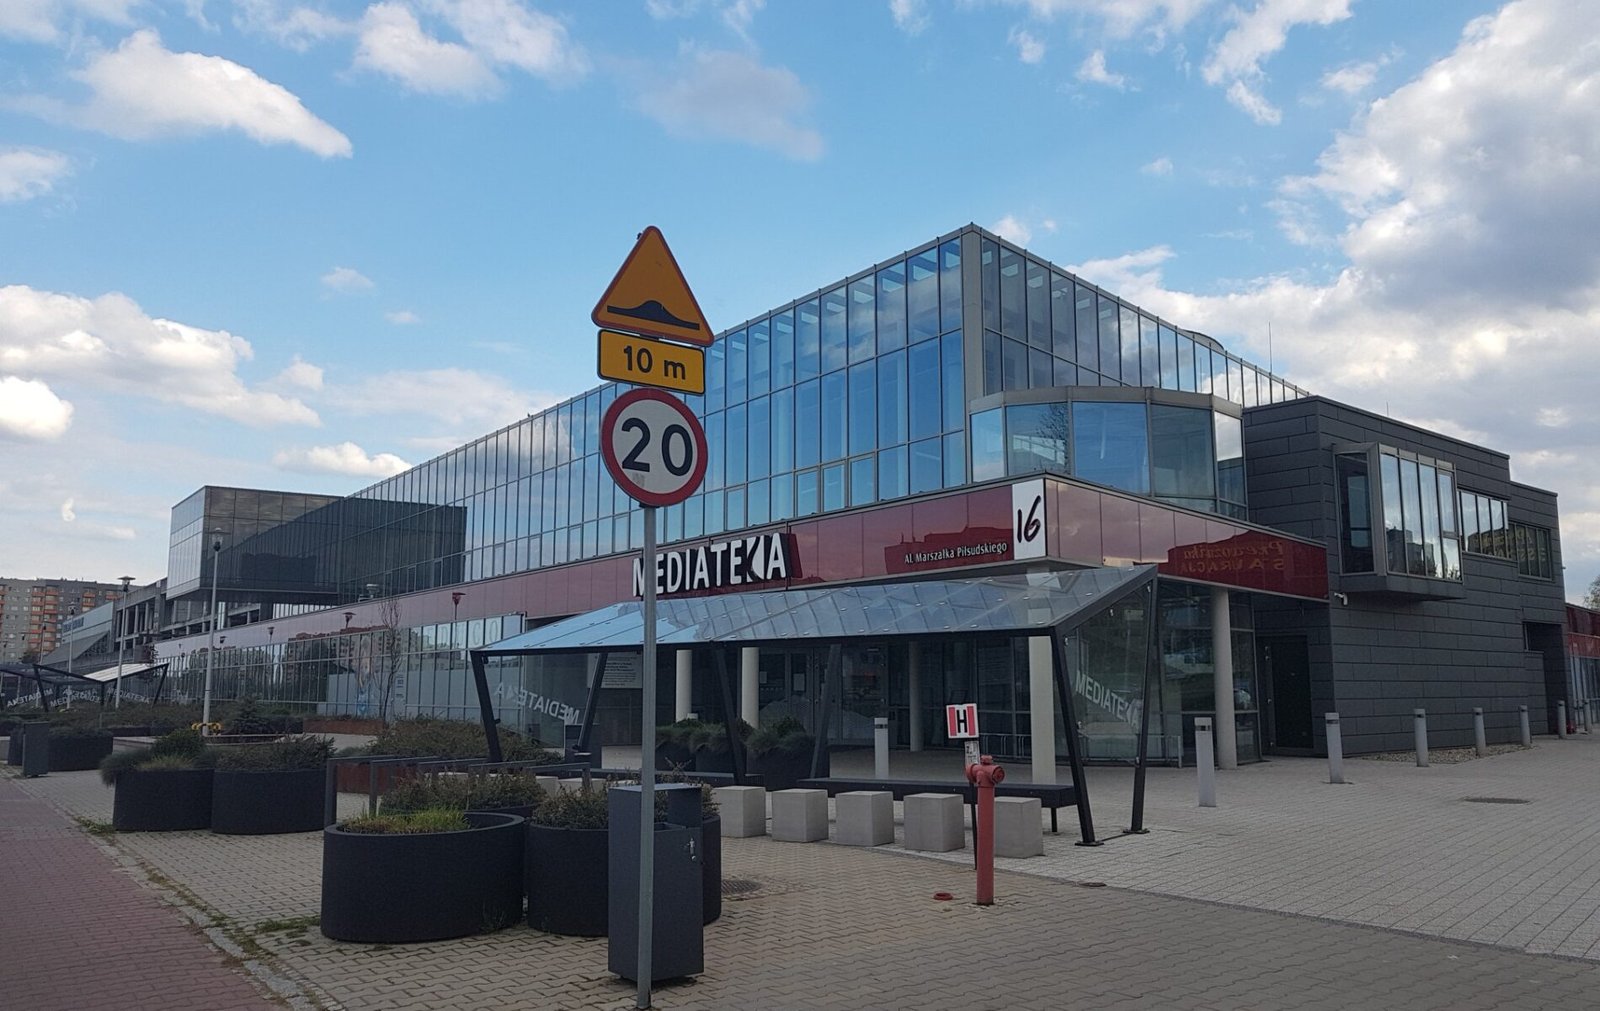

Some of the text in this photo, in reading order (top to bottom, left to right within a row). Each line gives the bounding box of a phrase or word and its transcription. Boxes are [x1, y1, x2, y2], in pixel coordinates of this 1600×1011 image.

[623, 345, 686, 380] 10 m
[621, 417, 693, 477] 20
[1017, 495, 1042, 544] 16
[915, 547, 955, 563] Marszałka
[956, 542, 1008, 558] Piłsudskiego
[956, 709, 968, 733] H
